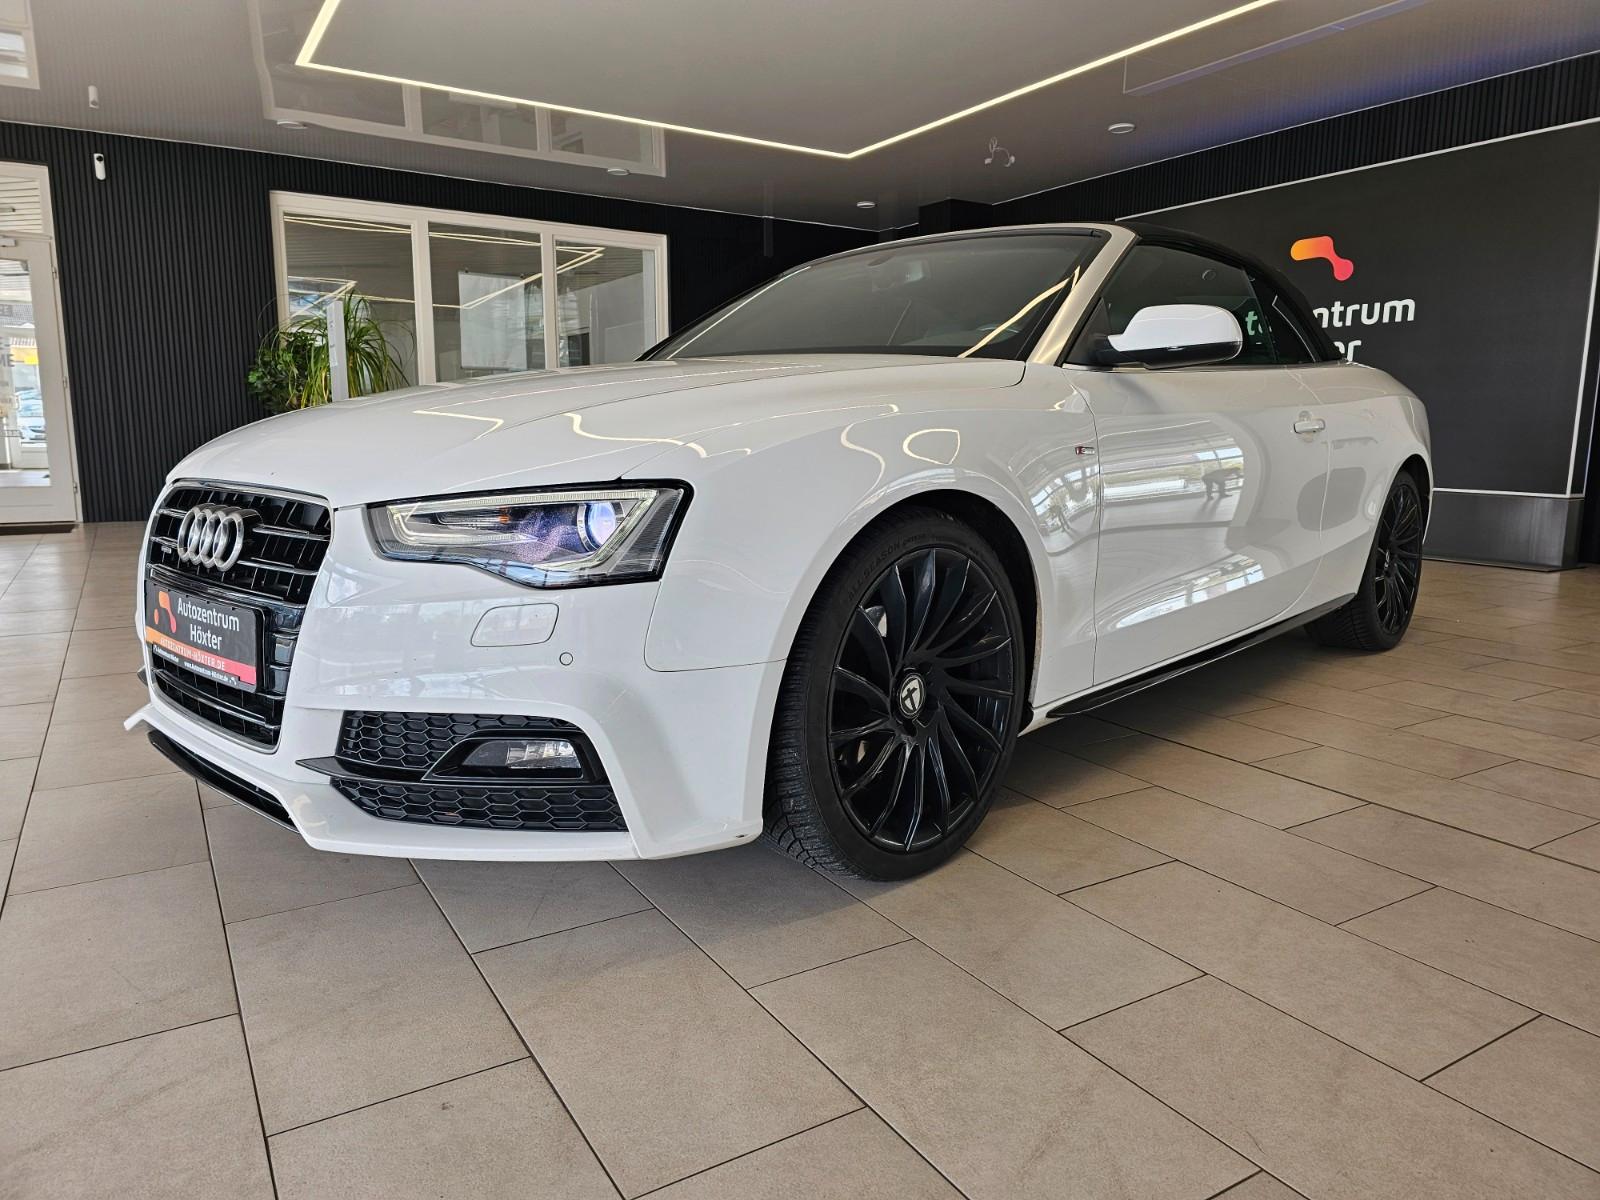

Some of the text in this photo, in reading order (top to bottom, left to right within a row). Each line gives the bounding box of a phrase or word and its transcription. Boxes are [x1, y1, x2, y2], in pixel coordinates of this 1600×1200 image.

[1244, 298, 1416, 336] tntrum
[177, 597, 240, 632] Autozentrum
[189, 623, 222, 650] Höxter
